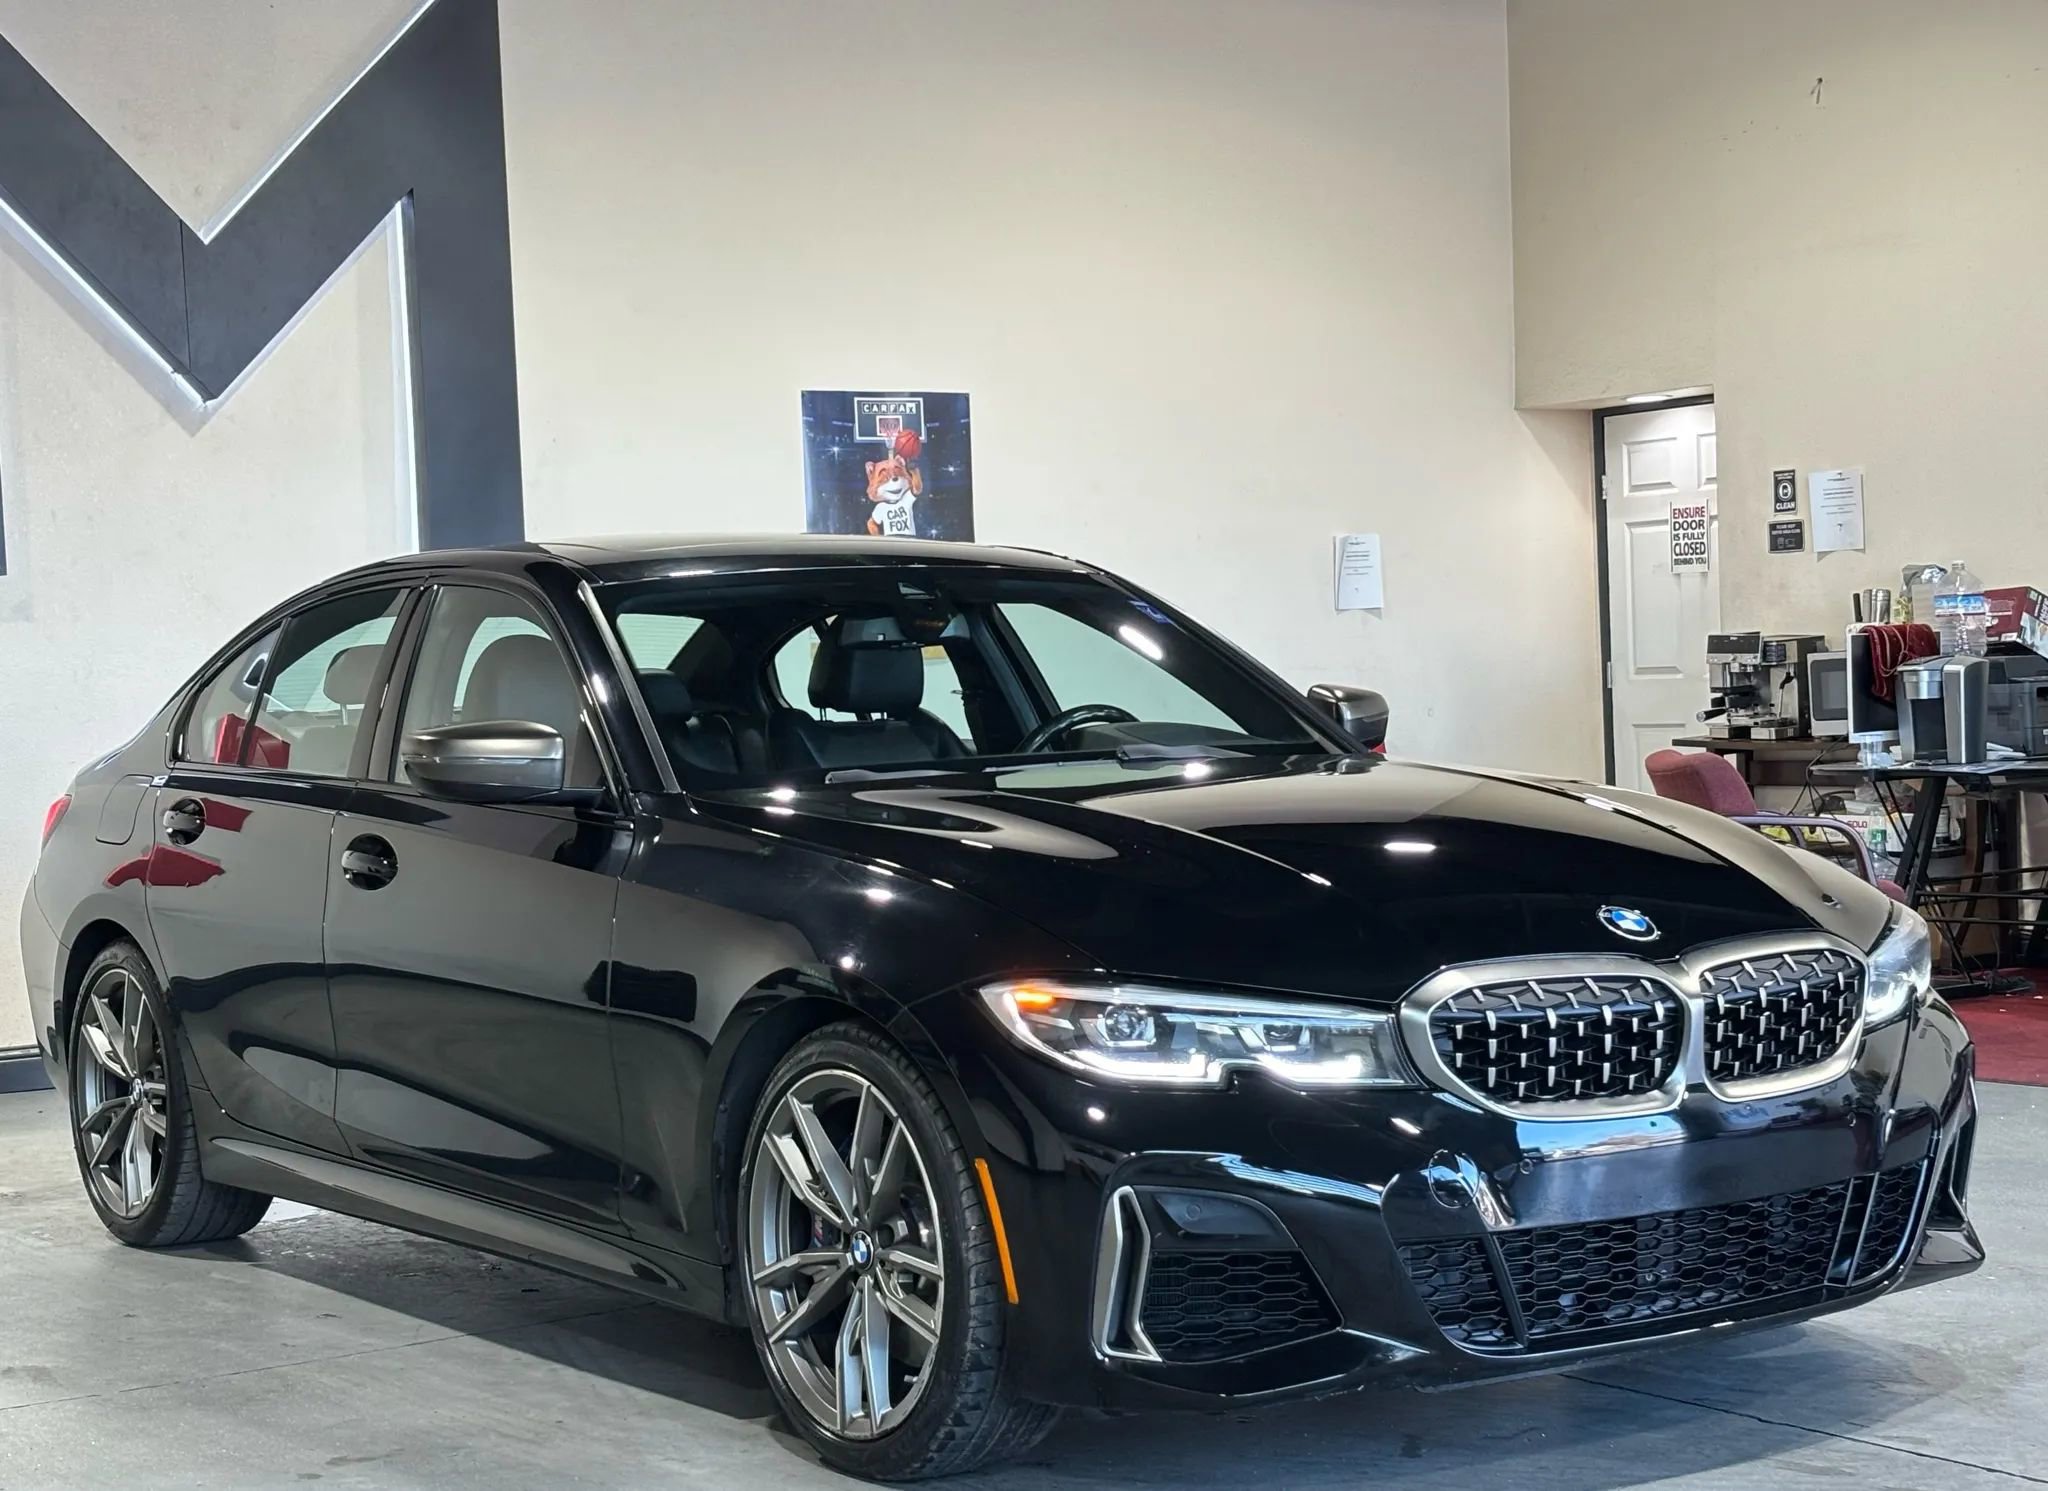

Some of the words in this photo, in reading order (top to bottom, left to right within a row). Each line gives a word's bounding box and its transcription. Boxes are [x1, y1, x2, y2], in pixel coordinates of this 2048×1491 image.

[863, 403, 917, 413] CARFAX
[887, 506, 908, 520] CAR
[1673, 506, 1706, 520] ENSURE
[889, 517, 910, 532] FOX
[1673, 519, 1705, 532] DOOR
[1673, 532, 1681, 541] IS
[1682, 531, 1705, 541] FULLY
[1673, 541, 1706, 557] CLOSED
[1694, 556, 1707, 565] YOU
